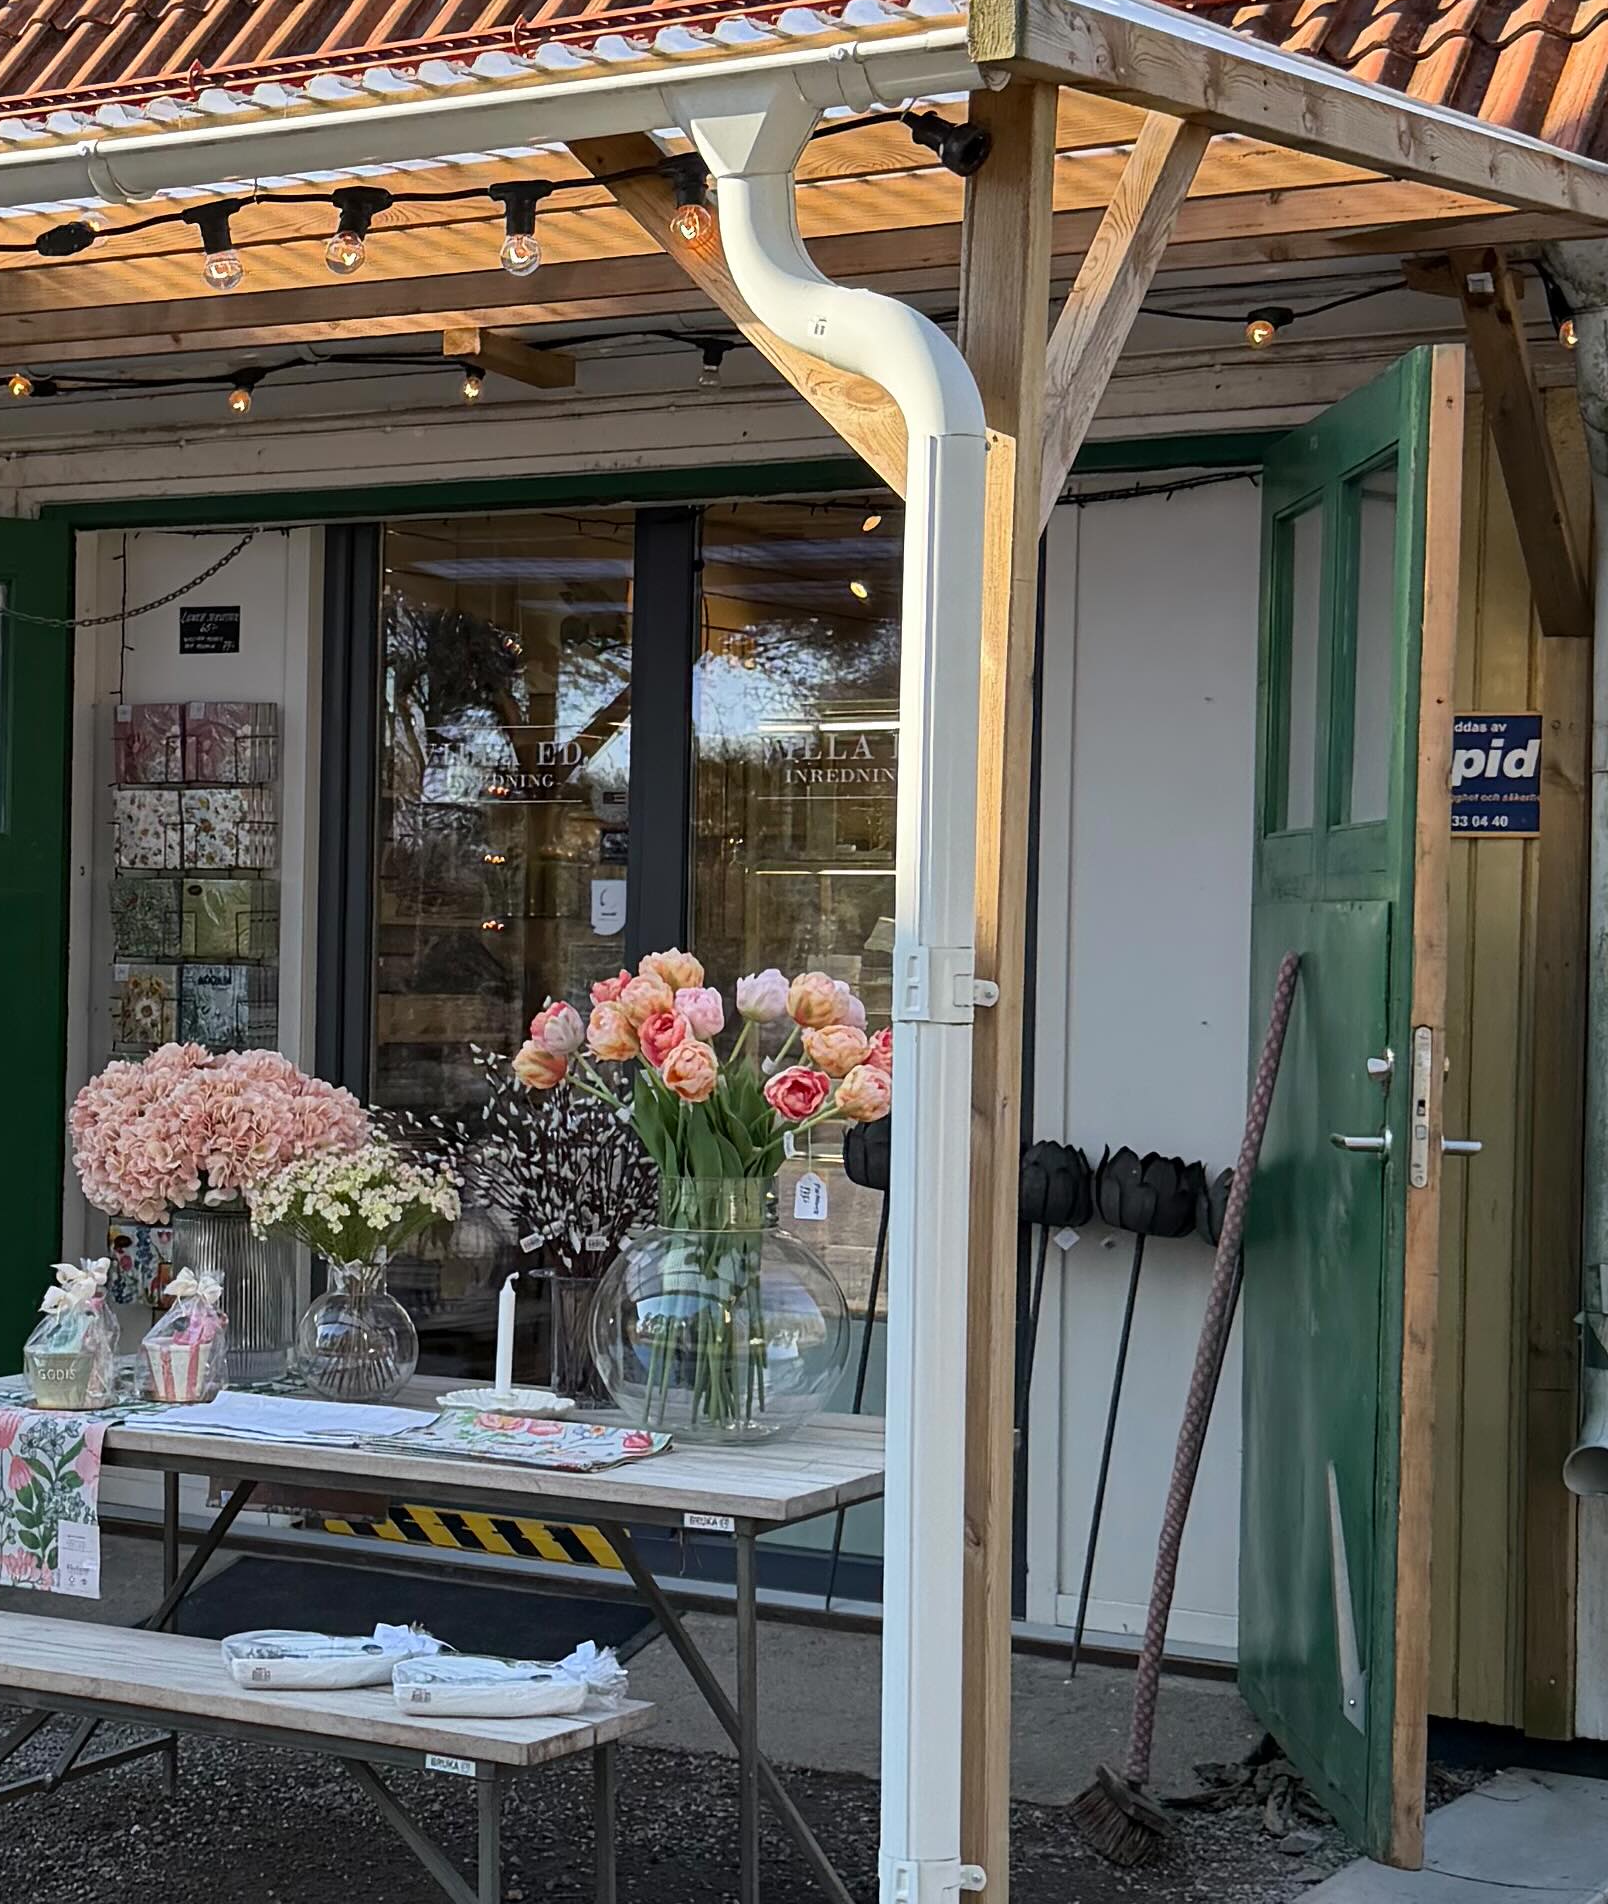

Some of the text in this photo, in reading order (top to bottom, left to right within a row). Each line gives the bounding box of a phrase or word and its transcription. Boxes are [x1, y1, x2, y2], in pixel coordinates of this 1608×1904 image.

[1490, 722, 1508, 733] av
[761, 733, 875, 762] VILLA
[1452, 738, 1541, 787] pid
[1471, 815, 1489, 827] 04
[1491, 815, 1509, 827] 40
[37, 1368, 78, 1381] GODIS
